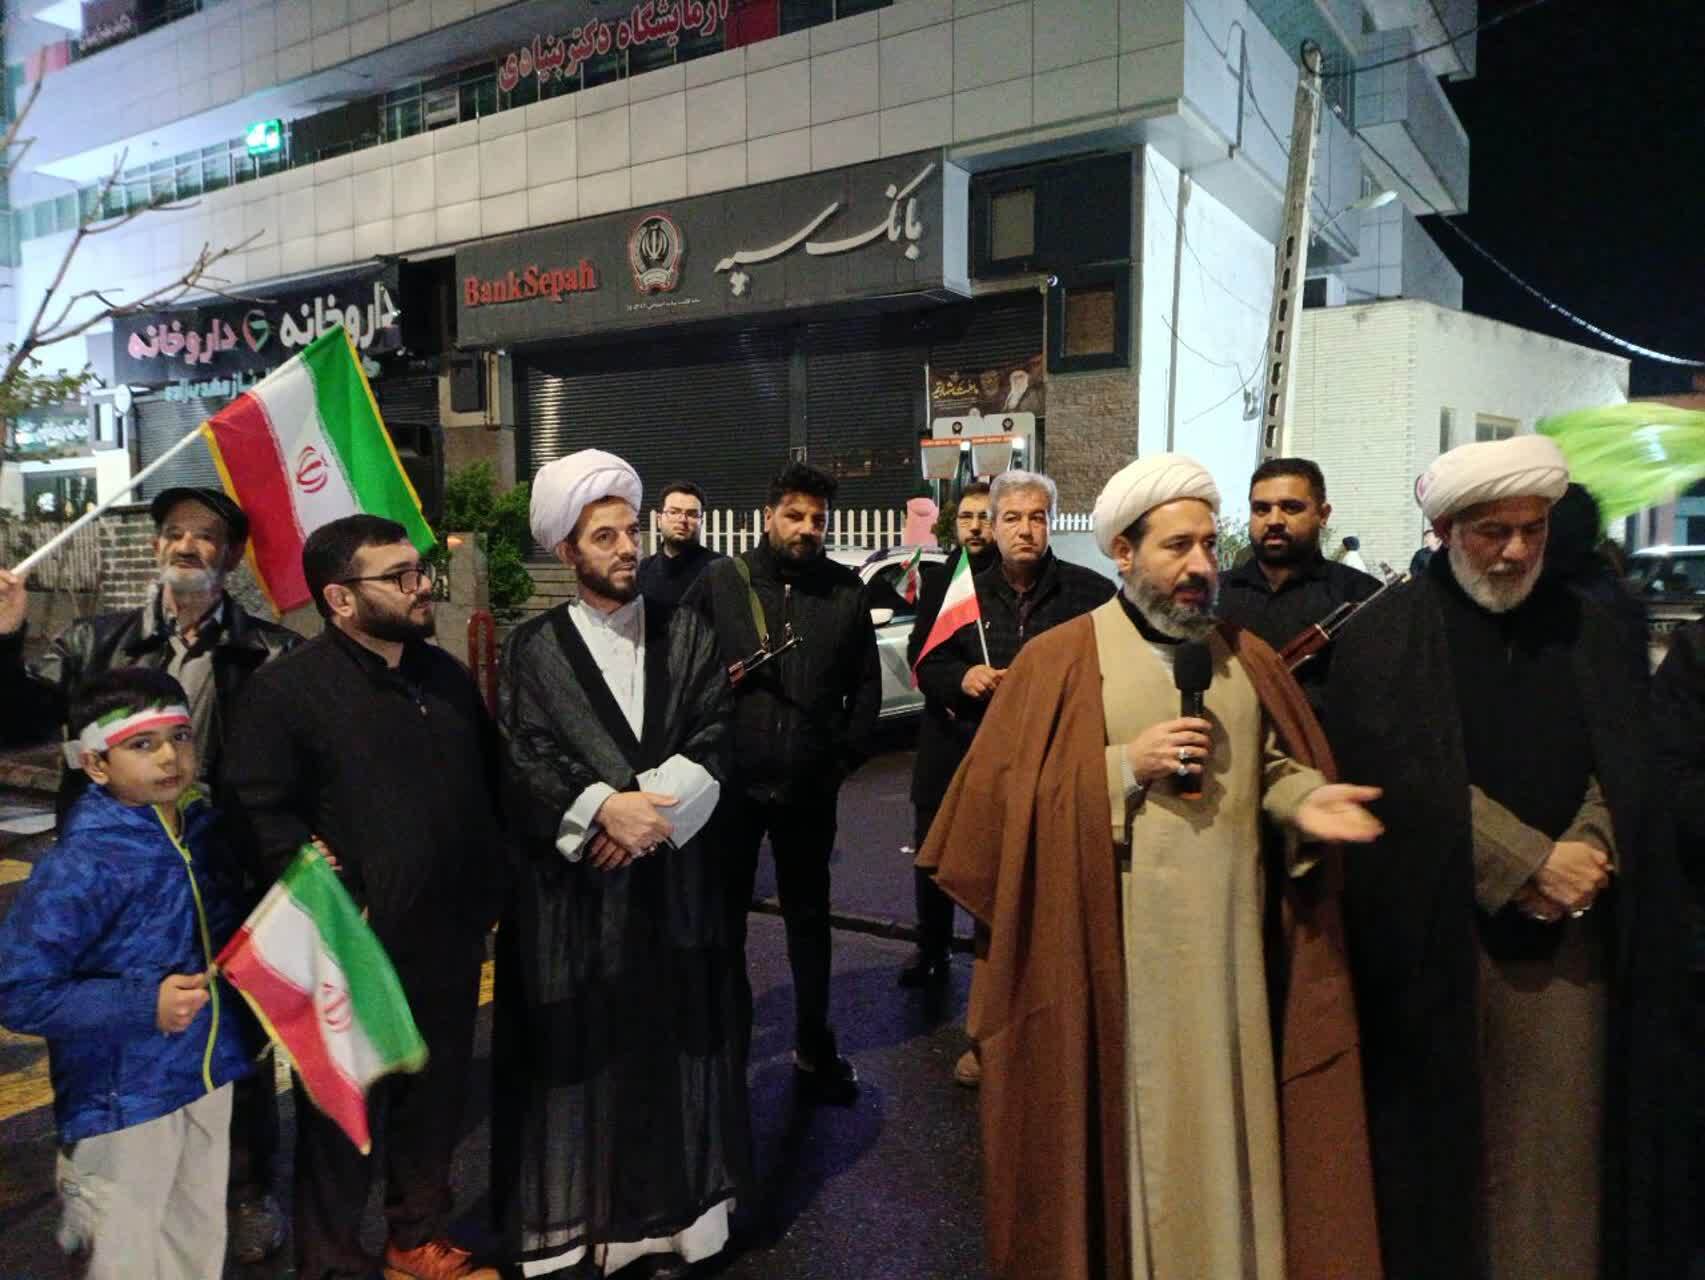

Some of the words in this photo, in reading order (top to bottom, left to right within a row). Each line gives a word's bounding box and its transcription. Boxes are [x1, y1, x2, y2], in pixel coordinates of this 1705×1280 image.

[499, 34, 566, 92] بنیادی
[564, 18, 612, 77] دکتر
[805, 162, 937, 260] بانک
[713, 201, 840, 297] سپه
[127, 317, 239, 366] داروخانه
[279, 280, 398, 350] داروخانه
